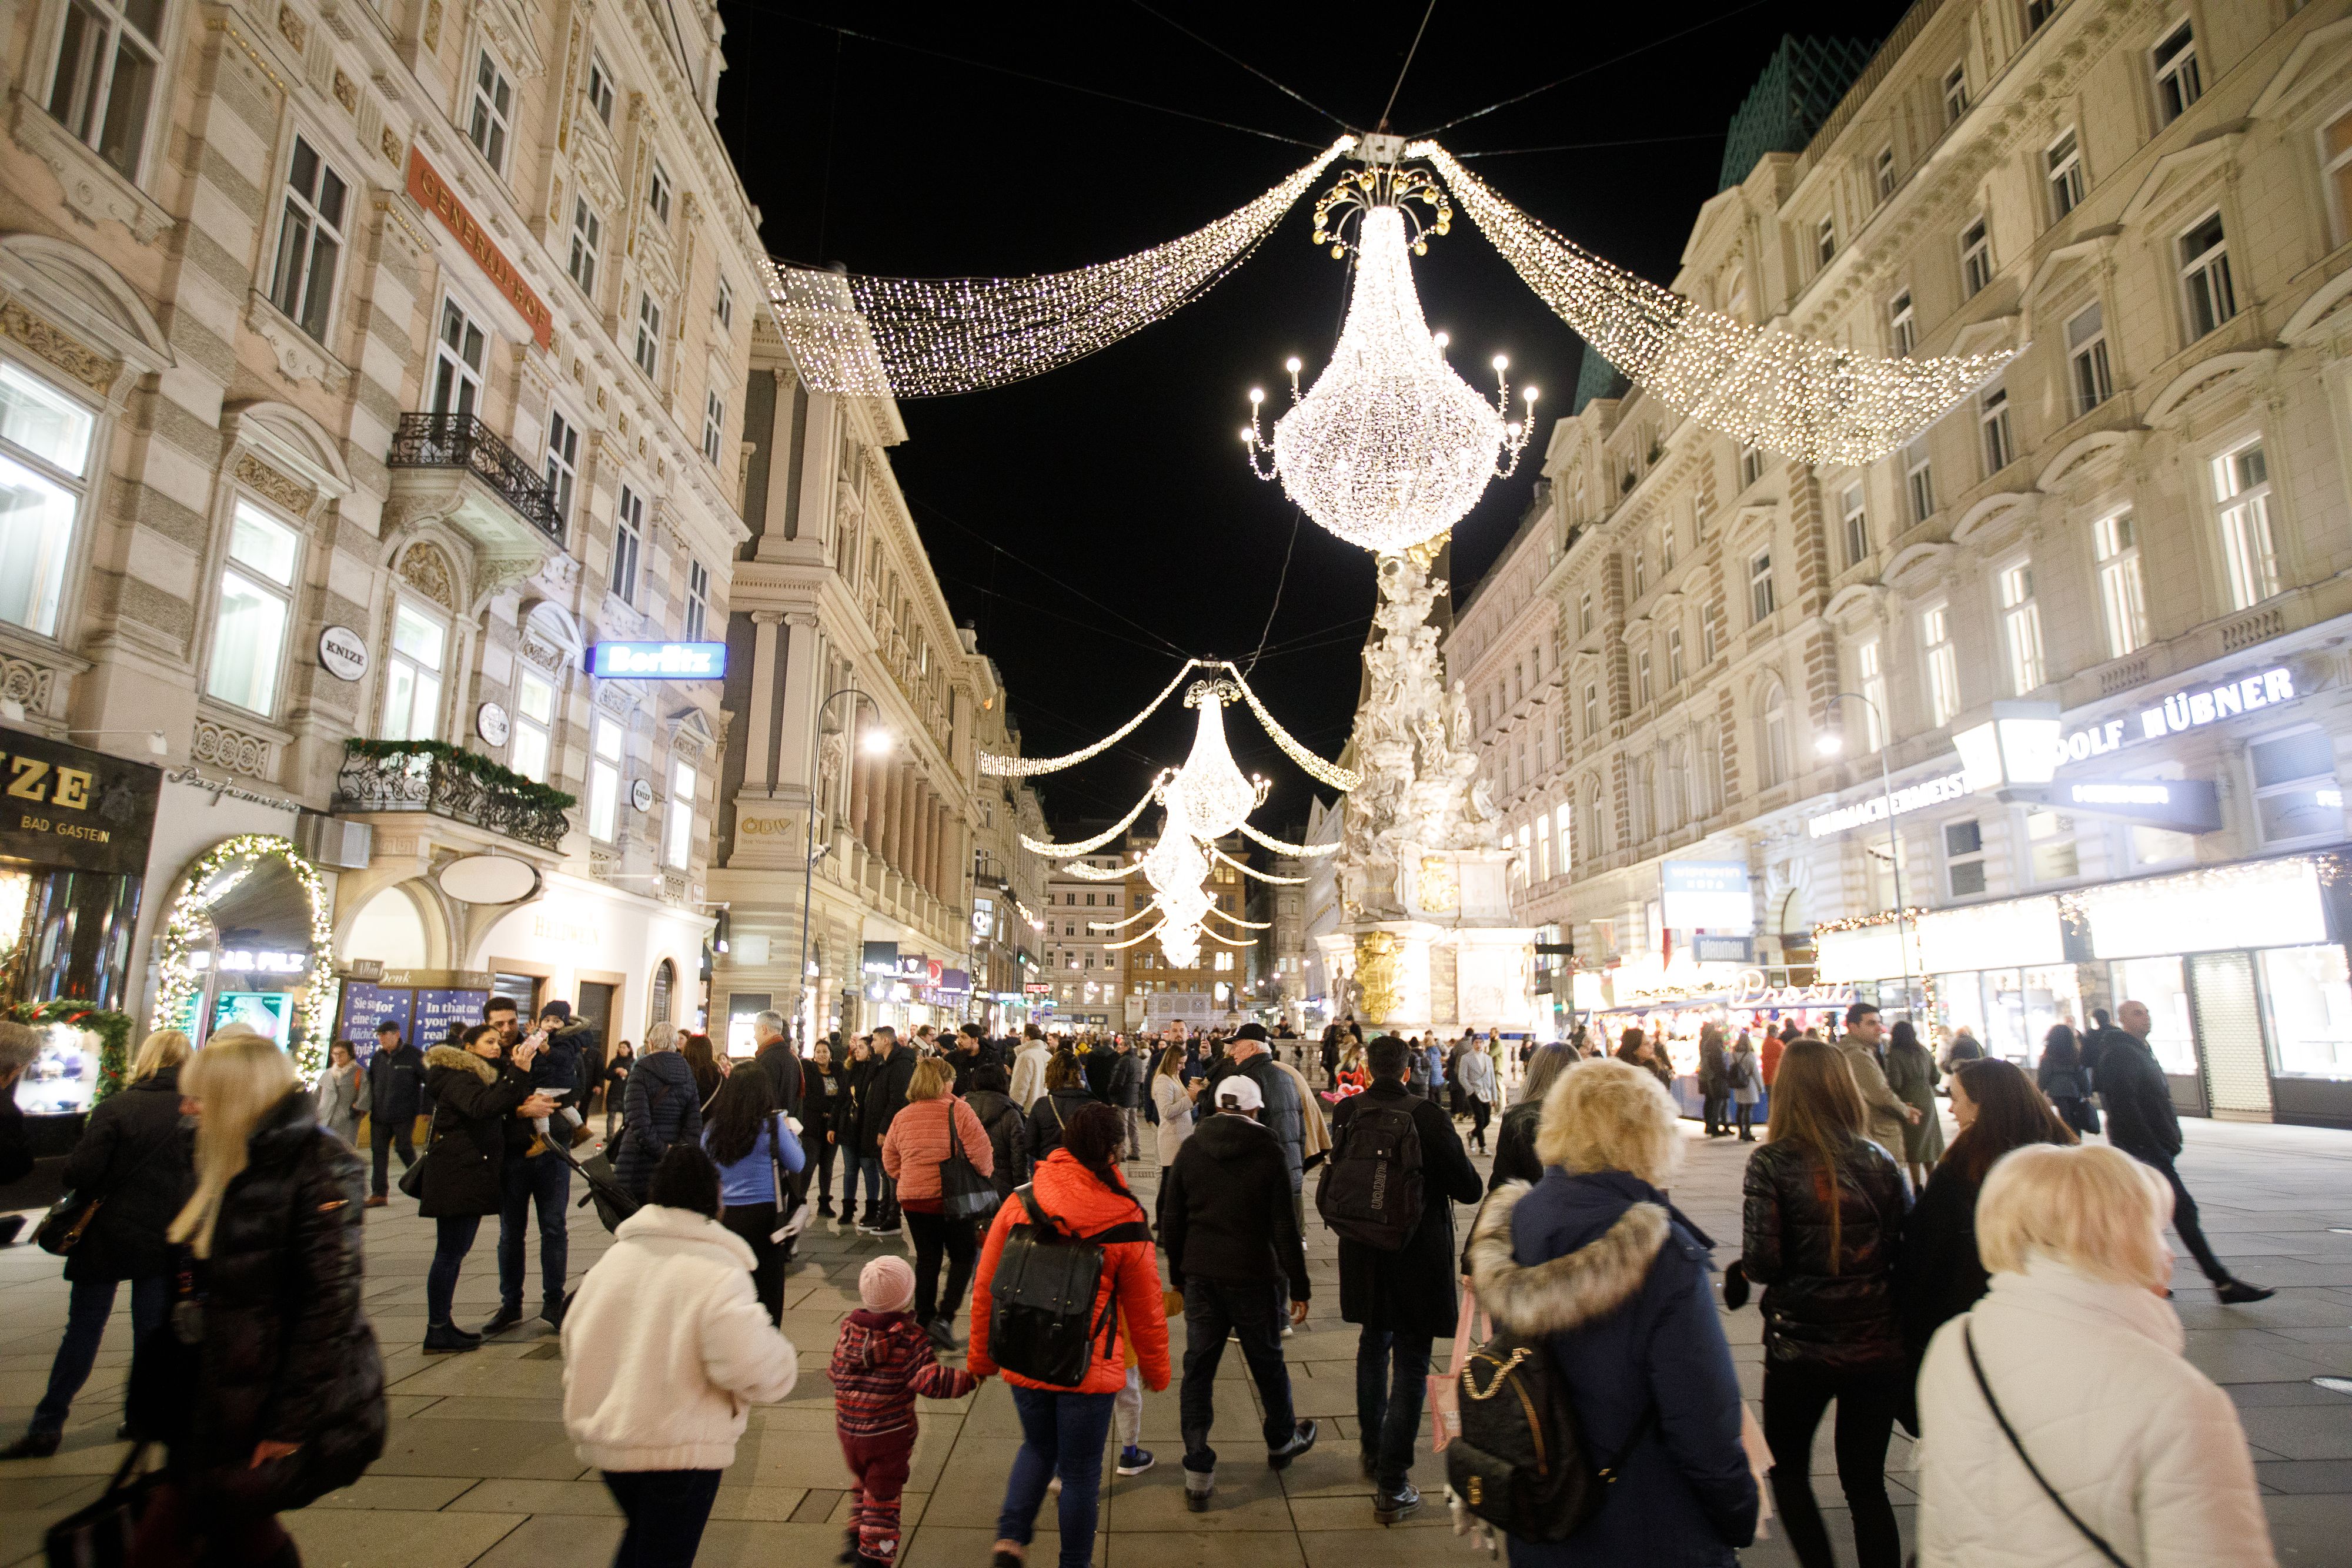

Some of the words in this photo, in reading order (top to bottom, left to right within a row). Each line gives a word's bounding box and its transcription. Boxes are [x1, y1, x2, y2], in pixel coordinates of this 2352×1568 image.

[326, 640, 365, 666] KNIZE
[608, 645, 711, 673] Berlitz
[2140, 668, 2293, 738] HÜBNER
[21, 815, 49, 831] BAD
[56, 824, 110, 842] GASTEIN
[426, 1002, 440, 1013] In
[442, 1002, 466, 1013] that
